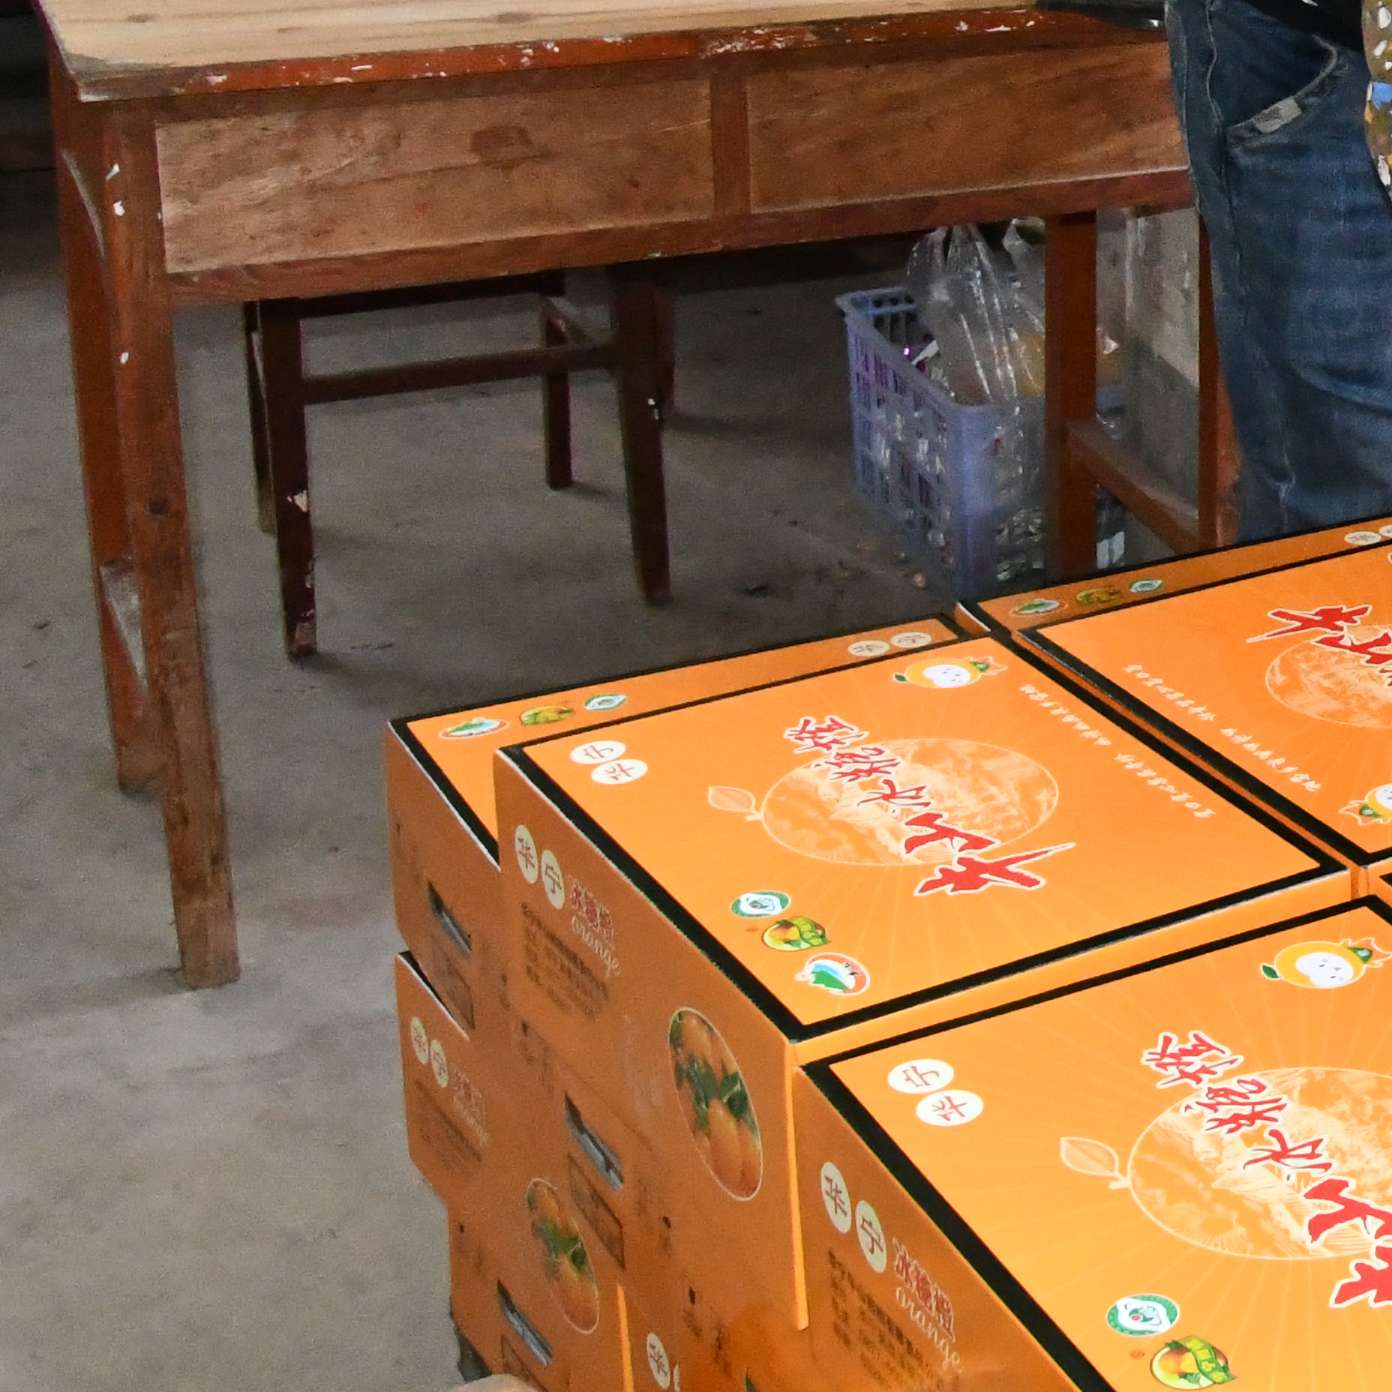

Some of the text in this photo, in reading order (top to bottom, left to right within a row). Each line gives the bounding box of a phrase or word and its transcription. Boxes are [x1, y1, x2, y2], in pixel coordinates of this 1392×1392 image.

[572, 742, 645, 783] 华宁
[784, 715, 1074, 896] 牛山冰糖橙
[890, 1060, 981, 1124] 华宁
[822, 1166, 886, 1268] 华宁
